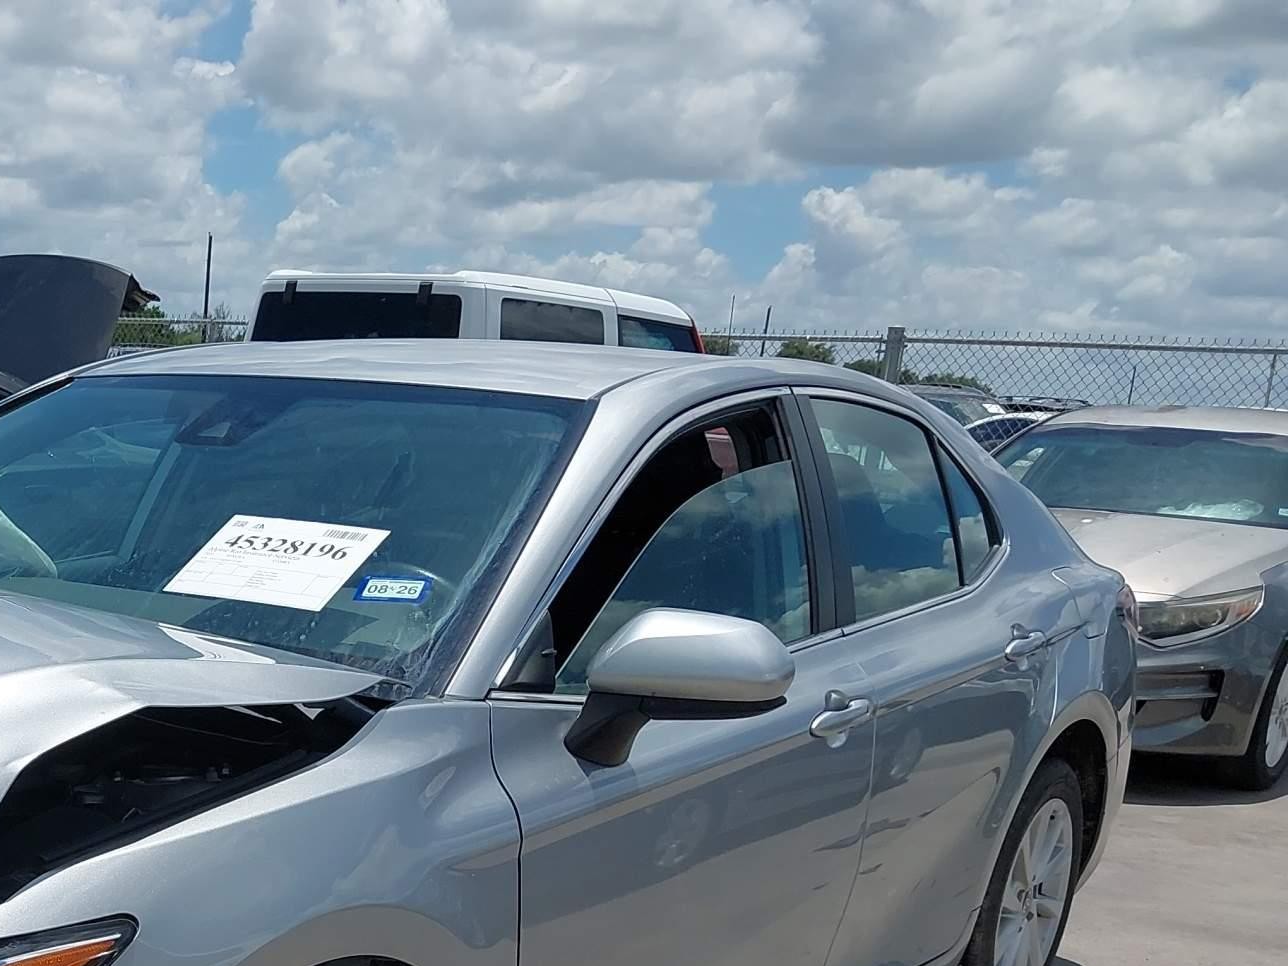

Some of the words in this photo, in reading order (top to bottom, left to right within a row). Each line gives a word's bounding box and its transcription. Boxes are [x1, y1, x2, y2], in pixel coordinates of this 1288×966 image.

[224, 533, 353, 561] 45328196
[367, 584, 389, 594] 08
[396, 585, 419, 595] 26
